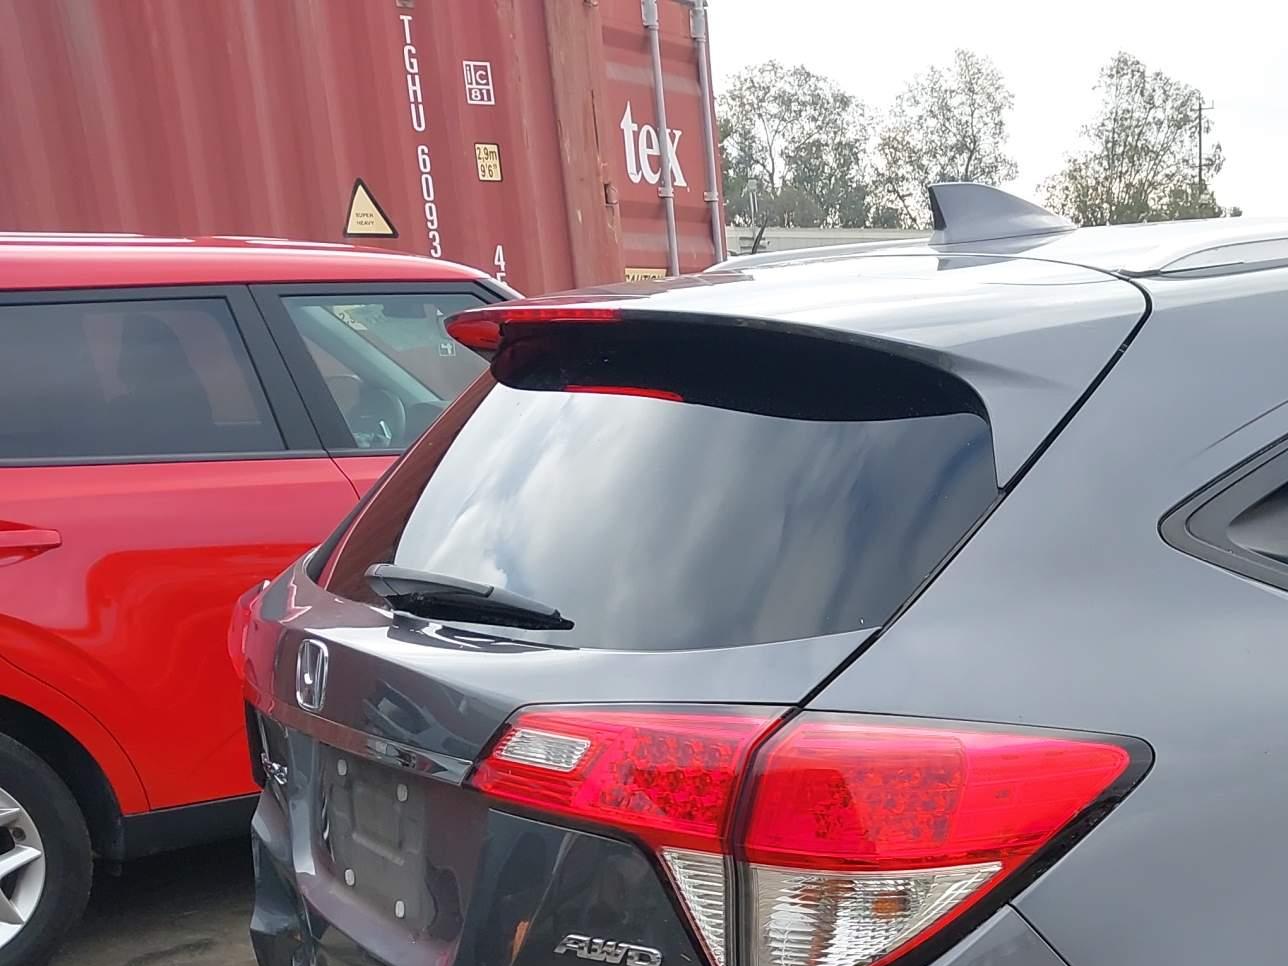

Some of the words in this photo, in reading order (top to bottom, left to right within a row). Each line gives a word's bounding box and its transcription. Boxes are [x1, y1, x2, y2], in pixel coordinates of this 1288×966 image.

[400, 15, 426, 132] TGHU
[417, 145, 442, 258] 6093
[471, 88, 489, 101] 81
[620, 100, 688, 187] tex
